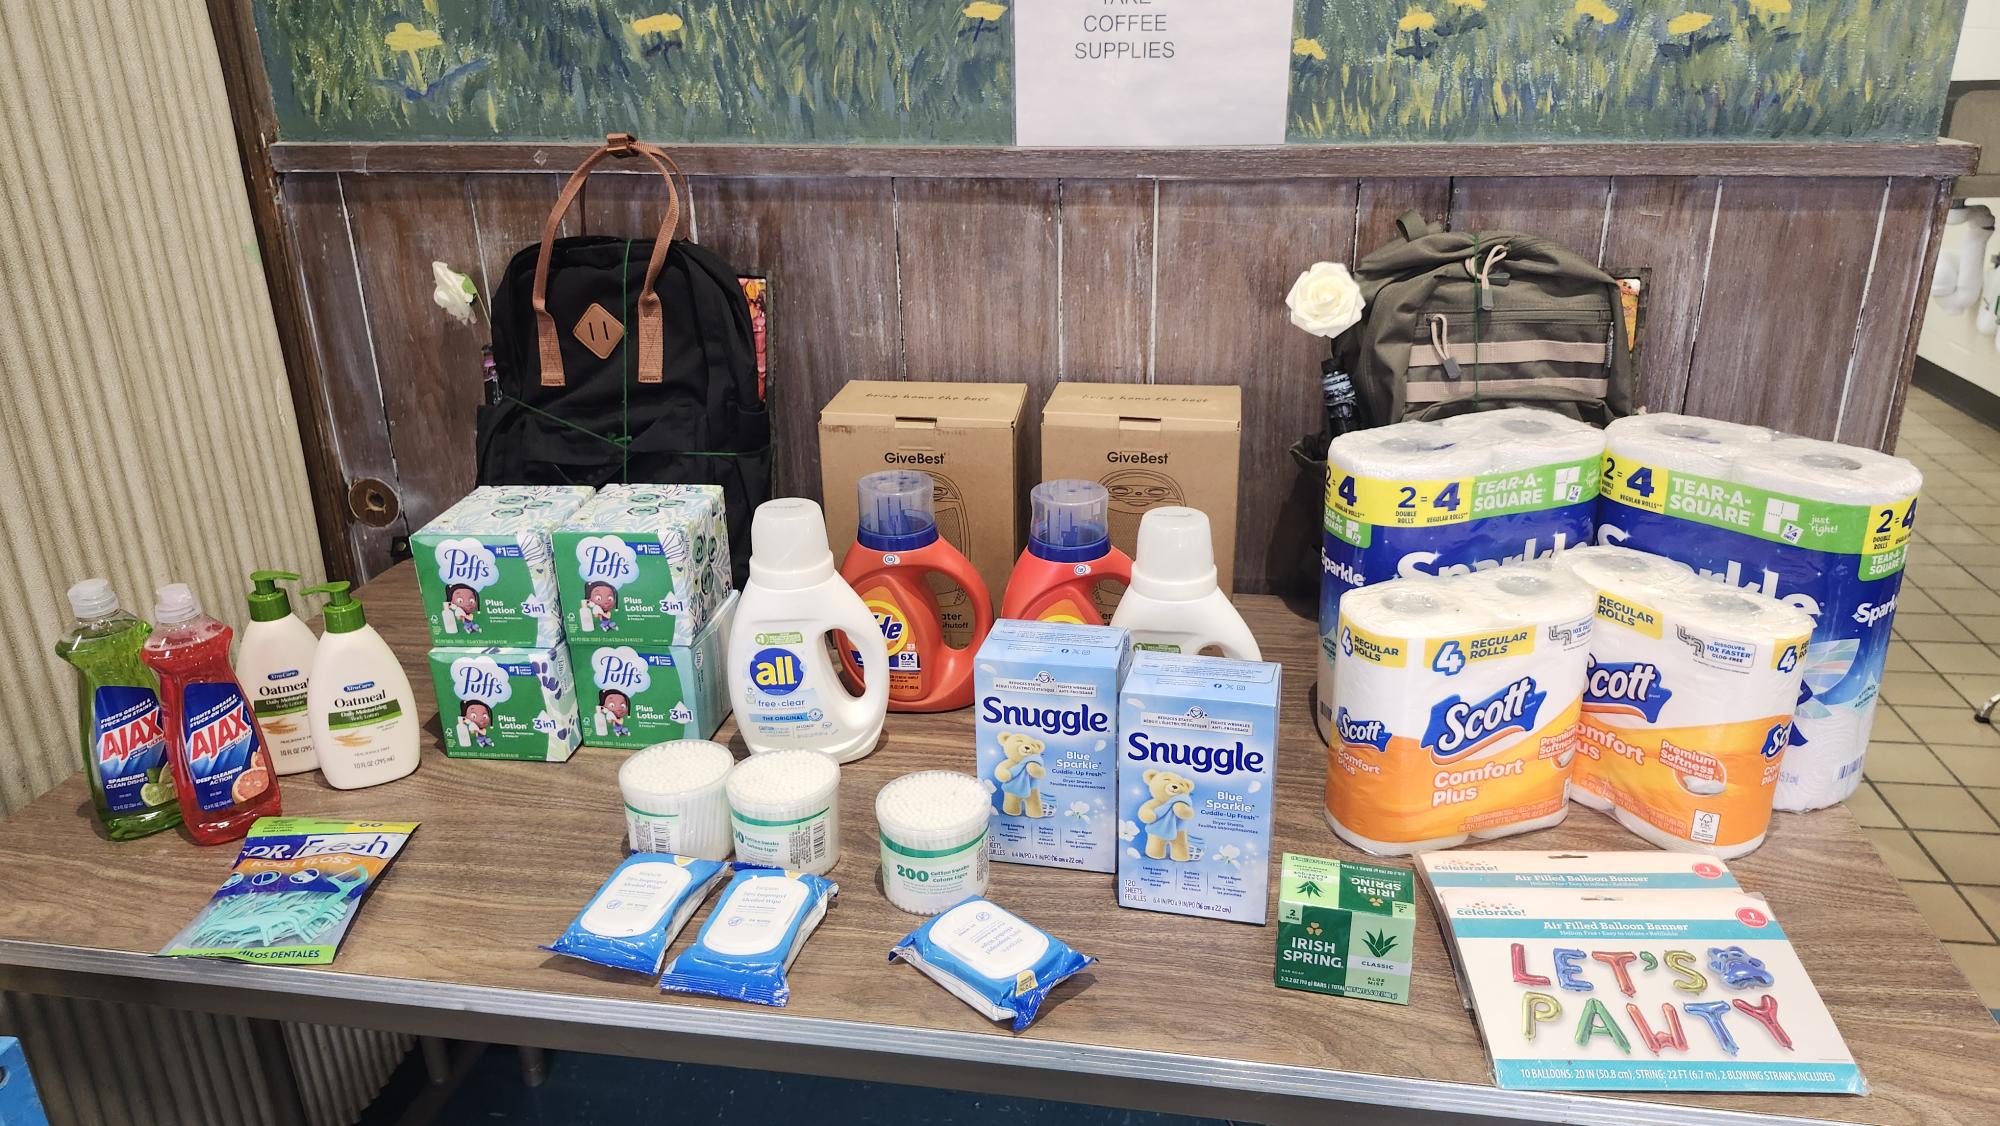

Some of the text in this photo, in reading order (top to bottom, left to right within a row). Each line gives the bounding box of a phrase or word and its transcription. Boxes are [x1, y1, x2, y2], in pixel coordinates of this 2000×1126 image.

[1084, 15, 1168, 32] COFFEE
[1075, 42, 1175, 59] SUPPLIES
[884, 452, 946, 465] GiveBest
[1107, 451, 1170, 465] GiveBest
[1477, 473, 1543, 495] TEAR-A-
[1604, 457, 1616, 481] 2
[1627, 466, 1655, 498] 4
[1337, 475, 1358, 508] 4
[1397, 482, 1461, 512] 2 4
[1672, 477, 1752, 507] TEAR-A-
[1473, 489, 1543, 513] SQUARE
[1620, 494, 1641, 506] REGULAR
[1396, 510, 1417, 518] DOUBLE
[1669, 495, 1750, 527] SQUARE
[1397, 517, 1414, 525] ROLLS
[1811, 514, 1831, 528] just
[1876, 509, 1894, 533] 2
[495, 548, 507, 559] #1
[637, 544, 649, 555] #1
[444, 548, 490, 582] Puffs
[585, 545, 631, 579] Puffs
[1321, 548, 1365, 588] Sparkle
[485, 599, 504, 608] Plus
[623, 596, 642, 604] Plus
[486, 607, 516, 615] Lotion
[624, 605, 654, 613] Lotion
[1598, 605, 1635, 627] ROLLS
[1599, 595, 1654, 625] REGULAR
[1341, 625, 1354, 657] 4
[1354, 635, 1399, 656] REGULAR
[1354, 644, 1381, 662] ROLLS
[1432, 632, 1528, 676] 4 REGULAR
[1469, 645, 1508, 659] ROLLS
[1707, 644, 1720, 654] 10X
[648, 655, 660, 665] #1
[900, 653, 915, 662] 6X
[1777, 645, 1797, 674] 4
[508, 665, 520, 675] #1
[600, 656, 642, 688] Puffs
[756, 655, 795, 686] all
[459, 666, 503, 698] Puffs
[334, 689, 386, 709] Oatmeal
[758, 699, 806, 708] free clear
[100, 702, 146, 725] FIGHTS GREASE
[190, 698, 233, 724] FIGHTS GREASE
[190, 700, 236, 729] STUCK-ON STAINS
[341, 704, 388, 719] Daily Moisturizing
[635, 704, 654, 712] Plus
[1438, 676, 1531, 752] Scott
[100, 704, 151, 730] STUCK-ON STAINS
[497, 714, 516, 723] Plus
[637, 712, 664, 720] Lotion
[982, 695, 1109, 737] Snuggle
[192, 705, 248, 761] AJAX
[499, 722, 527, 730] Lotion
[1340, 713, 1382, 742] Scott
[102, 710, 163, 762] AJAX
[1066, 751, 1091, 761] Blue
[1127, 732, 1266, 776] Snuggle
[1661, 738, 1717, 767] Premium
[1056, 759, 1100, 772] Sparkle
[1338, 747, 1381, 775] Comfort
[1661, 749, 1715, 777] Softness
[108, 772, 145, 785] SPARKLING
[195, 766, 243, 785] DEEP CLEANING
[209, 774, 233, 787] ACTION
[1051, 768, 1103, 779] Cuddle-Up Fresh
[1434, 759, 1524, 789] Comfort
[105, 777, 149, 790] CLEAN DISHES
[1217, 791, 1243, 802] Blue
[1206, 800, 1252, 814] Sparkle
[1200, 810, 1255, 821] Cuddle-Up Fresh
[248, 835, 389, 859] DR. Fresh
[303, 856, 353, 866] FLOSS
[1434, 864, 1499, 873] celebrate!
[897, 864, 930, 883] 200
[930, 865, 970, 877] Cotton Swabs
[1534, 874, 1565, 882] Filled
[1566, 875, 1608, 883] Balloon
[1609, 875, 1649, 883] Banner
[1125, 879, 1136, 887] 120
[1351, 876, 1403, 892] SPRING
[1124, 887, 1143, 895] SHEETS
[1124, 894, 1147, 903] FEUILLES
[1357, 885, 1396, 899] IRISH
[1289, 909, 1296, 917] 2
[1456, 907, 1527, 918] celebrate!
[1544, 921, 1690, 932] Air Filled Balloon Banner
[1291, 936, 1336, 954] IRISH
[270, 950, 320, 959] DENTALES
[1282, 949, 1344, 969] SPRING
[1361, 960, 1395, 971] CLASSIC
[1509, 942, 1709, 999] LET'S
[1520, 990, 1795, 1058] PAWTY
[1521, 1068, 1836, 1083] 10 BALLOONS: 20 IN (50.8 cm), STRING: 22 FT (6.7 m), BLOWING STRAWS INCLUDED
